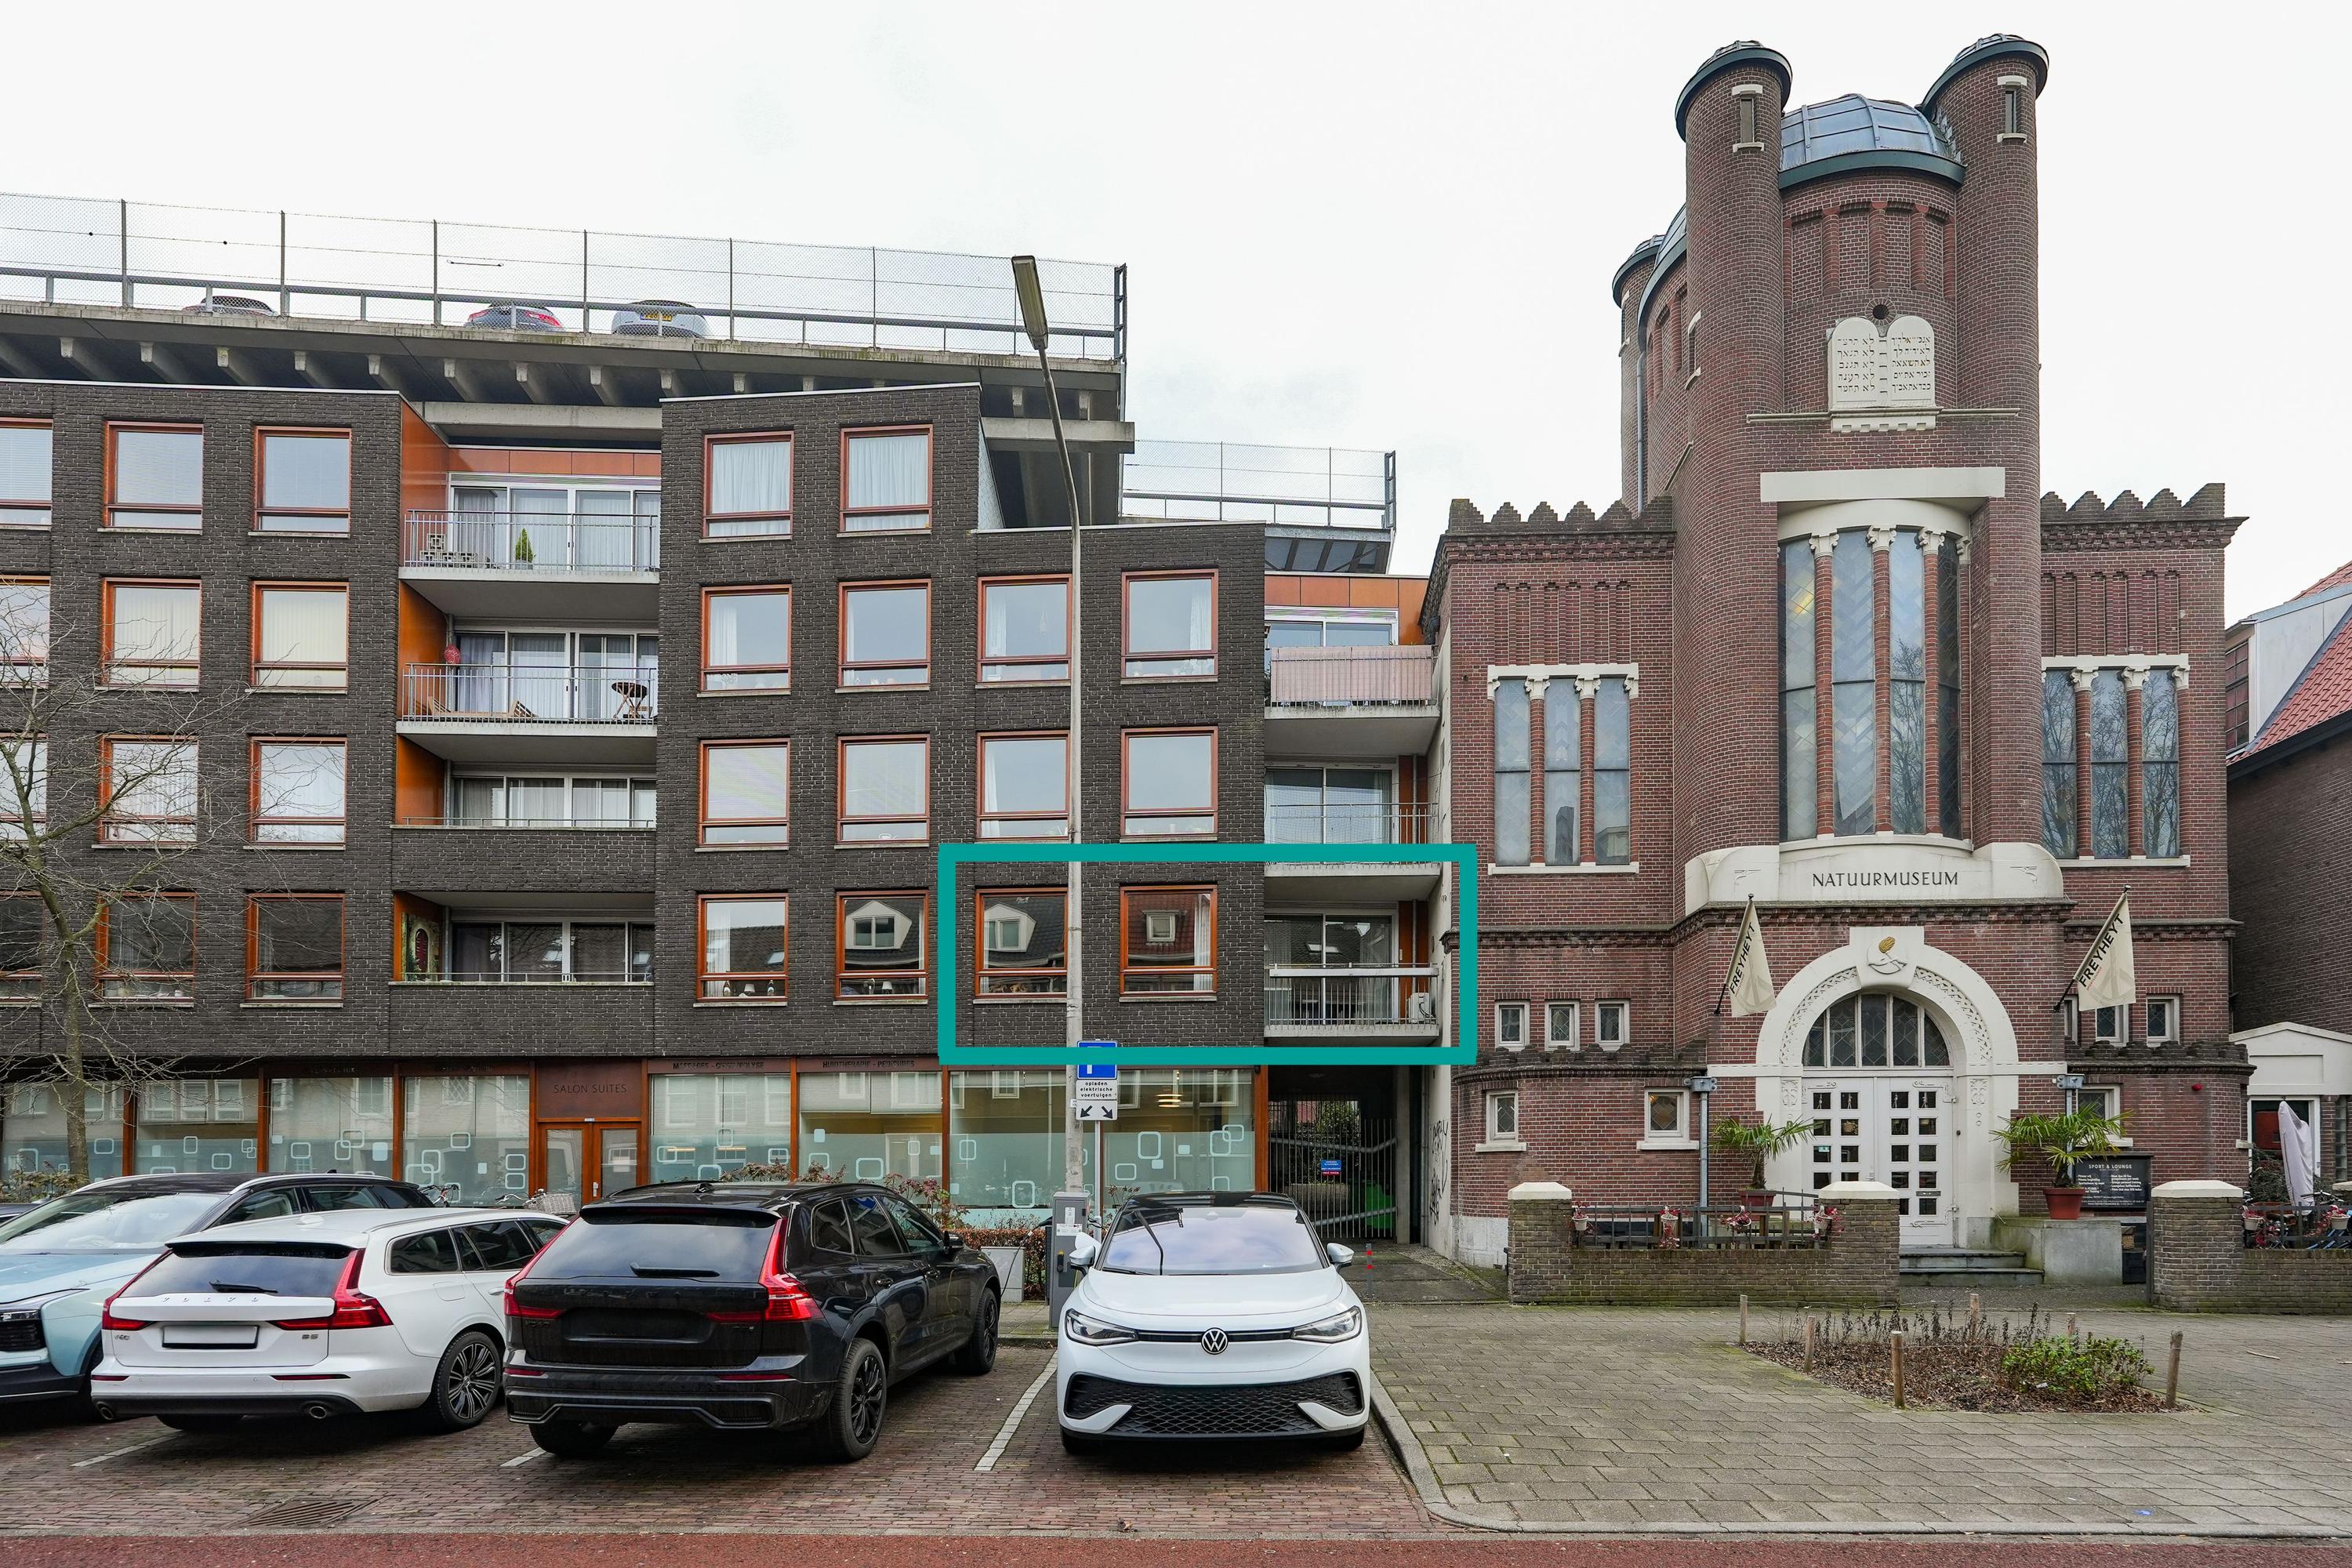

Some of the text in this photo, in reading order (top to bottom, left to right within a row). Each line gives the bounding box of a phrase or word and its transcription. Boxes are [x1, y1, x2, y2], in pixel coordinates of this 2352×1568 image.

[1863, 333, 1875, 344] לא
[1863, 346, 1875, 356] לא
[1863, 358, 1875, 368] לא
[1863, 368, 1875, 380] לא
[1863, 381, 1875, 391] לא
[1813, 872, 1958, 887] NATUURMUSEUM
[2079, 913, 2124, 987] FREYHEYT
[1730, 922, 1755, 995] FREYHEYT
[553, 1083, 627, 1094] SALON SUITES
